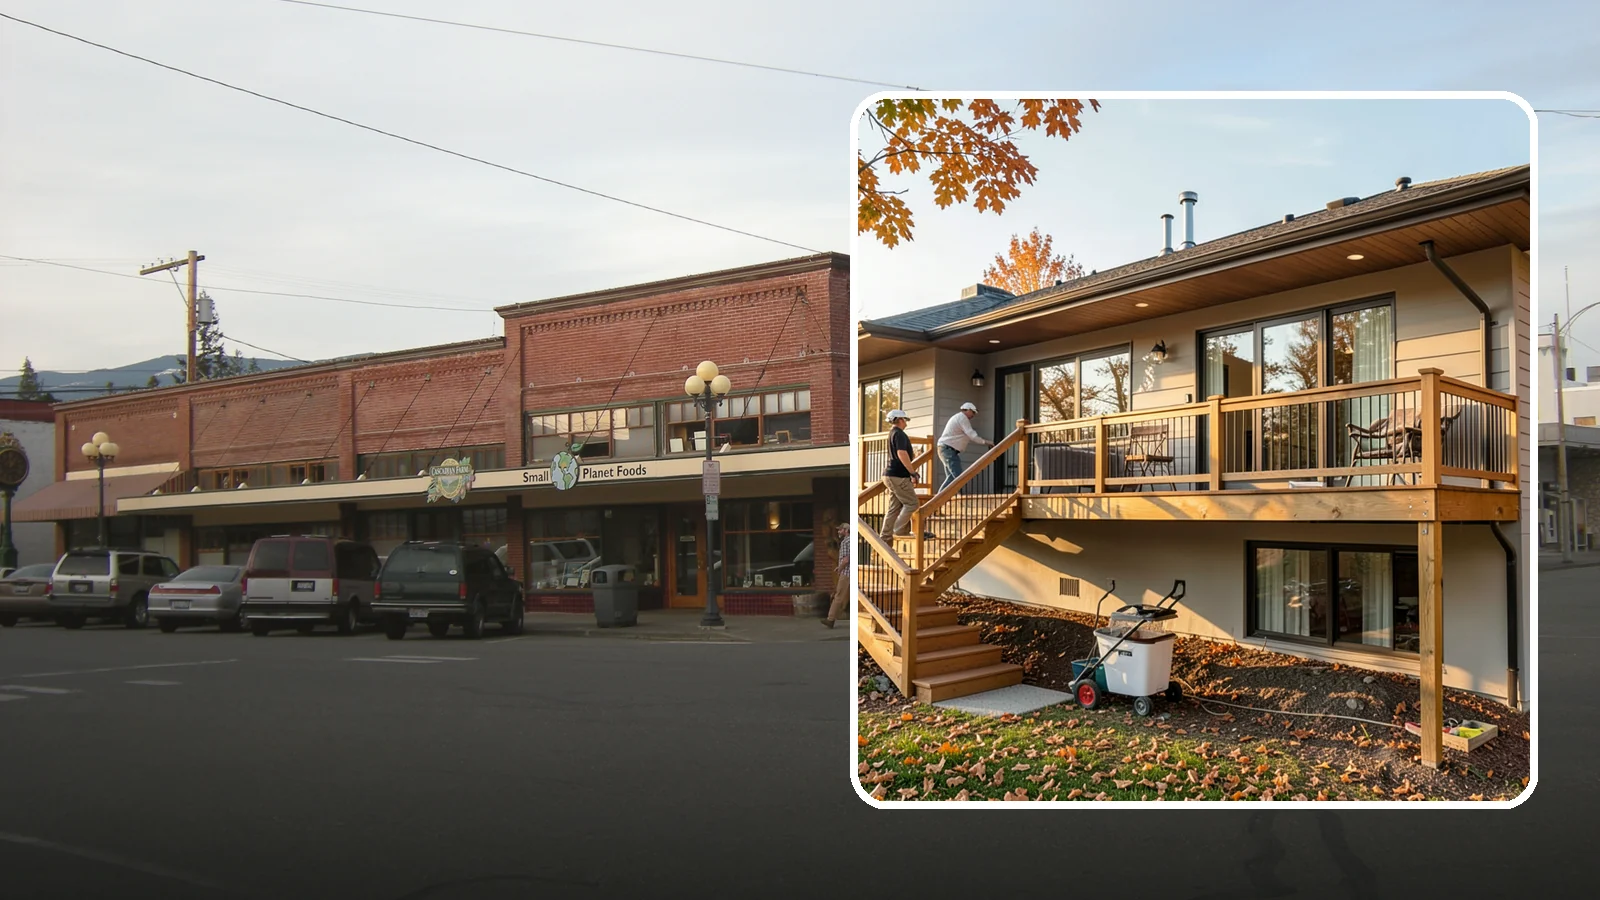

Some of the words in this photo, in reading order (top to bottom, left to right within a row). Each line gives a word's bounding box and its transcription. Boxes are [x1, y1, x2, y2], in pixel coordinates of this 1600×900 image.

[523, 471, 549, 483] Small
[583, 467, 614, 480] Planet
[617, 464, 647, 477] Foods
